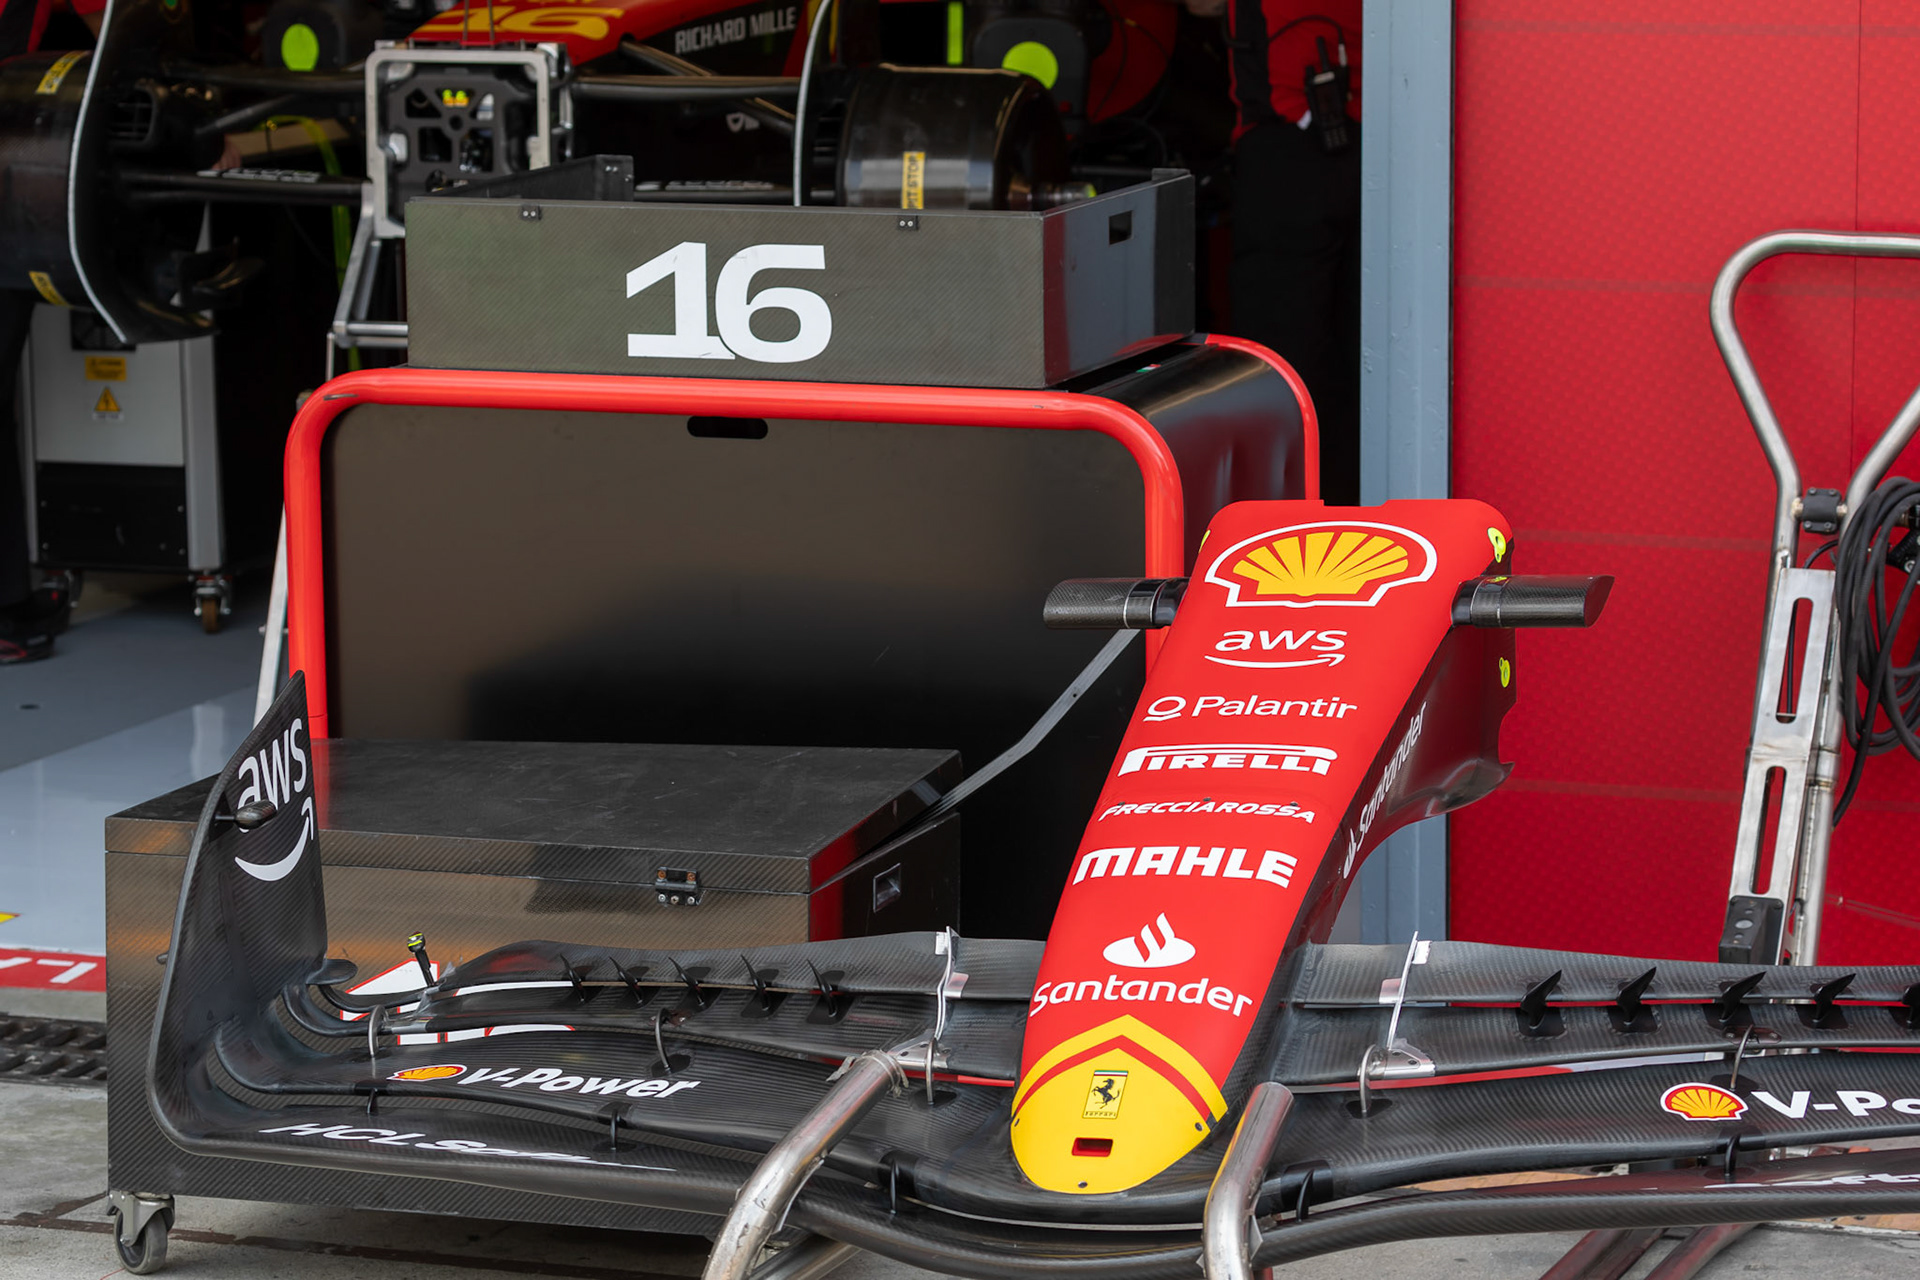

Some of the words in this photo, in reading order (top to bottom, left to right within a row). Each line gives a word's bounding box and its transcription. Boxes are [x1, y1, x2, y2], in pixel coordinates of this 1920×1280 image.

[414, 5, 625, 41] 16
[675, 17, 746, 55] RICHARD
[749, 7, 797, 38] MILLE
[907, 156, 919, 188] STOP
[626, 241, 833, 363] 16
[1214, 630, 1348, 651] aws
[1191, 695, 1358, 719] Palantir
[232, 717, 307, 833] aws
[1117, 743, 1338, 777] PIRELLI
[1357, 701, 1427, 851] Santander
[1097, 801, 1315, 824] FRECCIAROSSA
[1072, 846, 1298, 889] MAHLE
[1029, 974, 1253, 1017] Santander
[457, 1067, 701, 1098] V-Power
